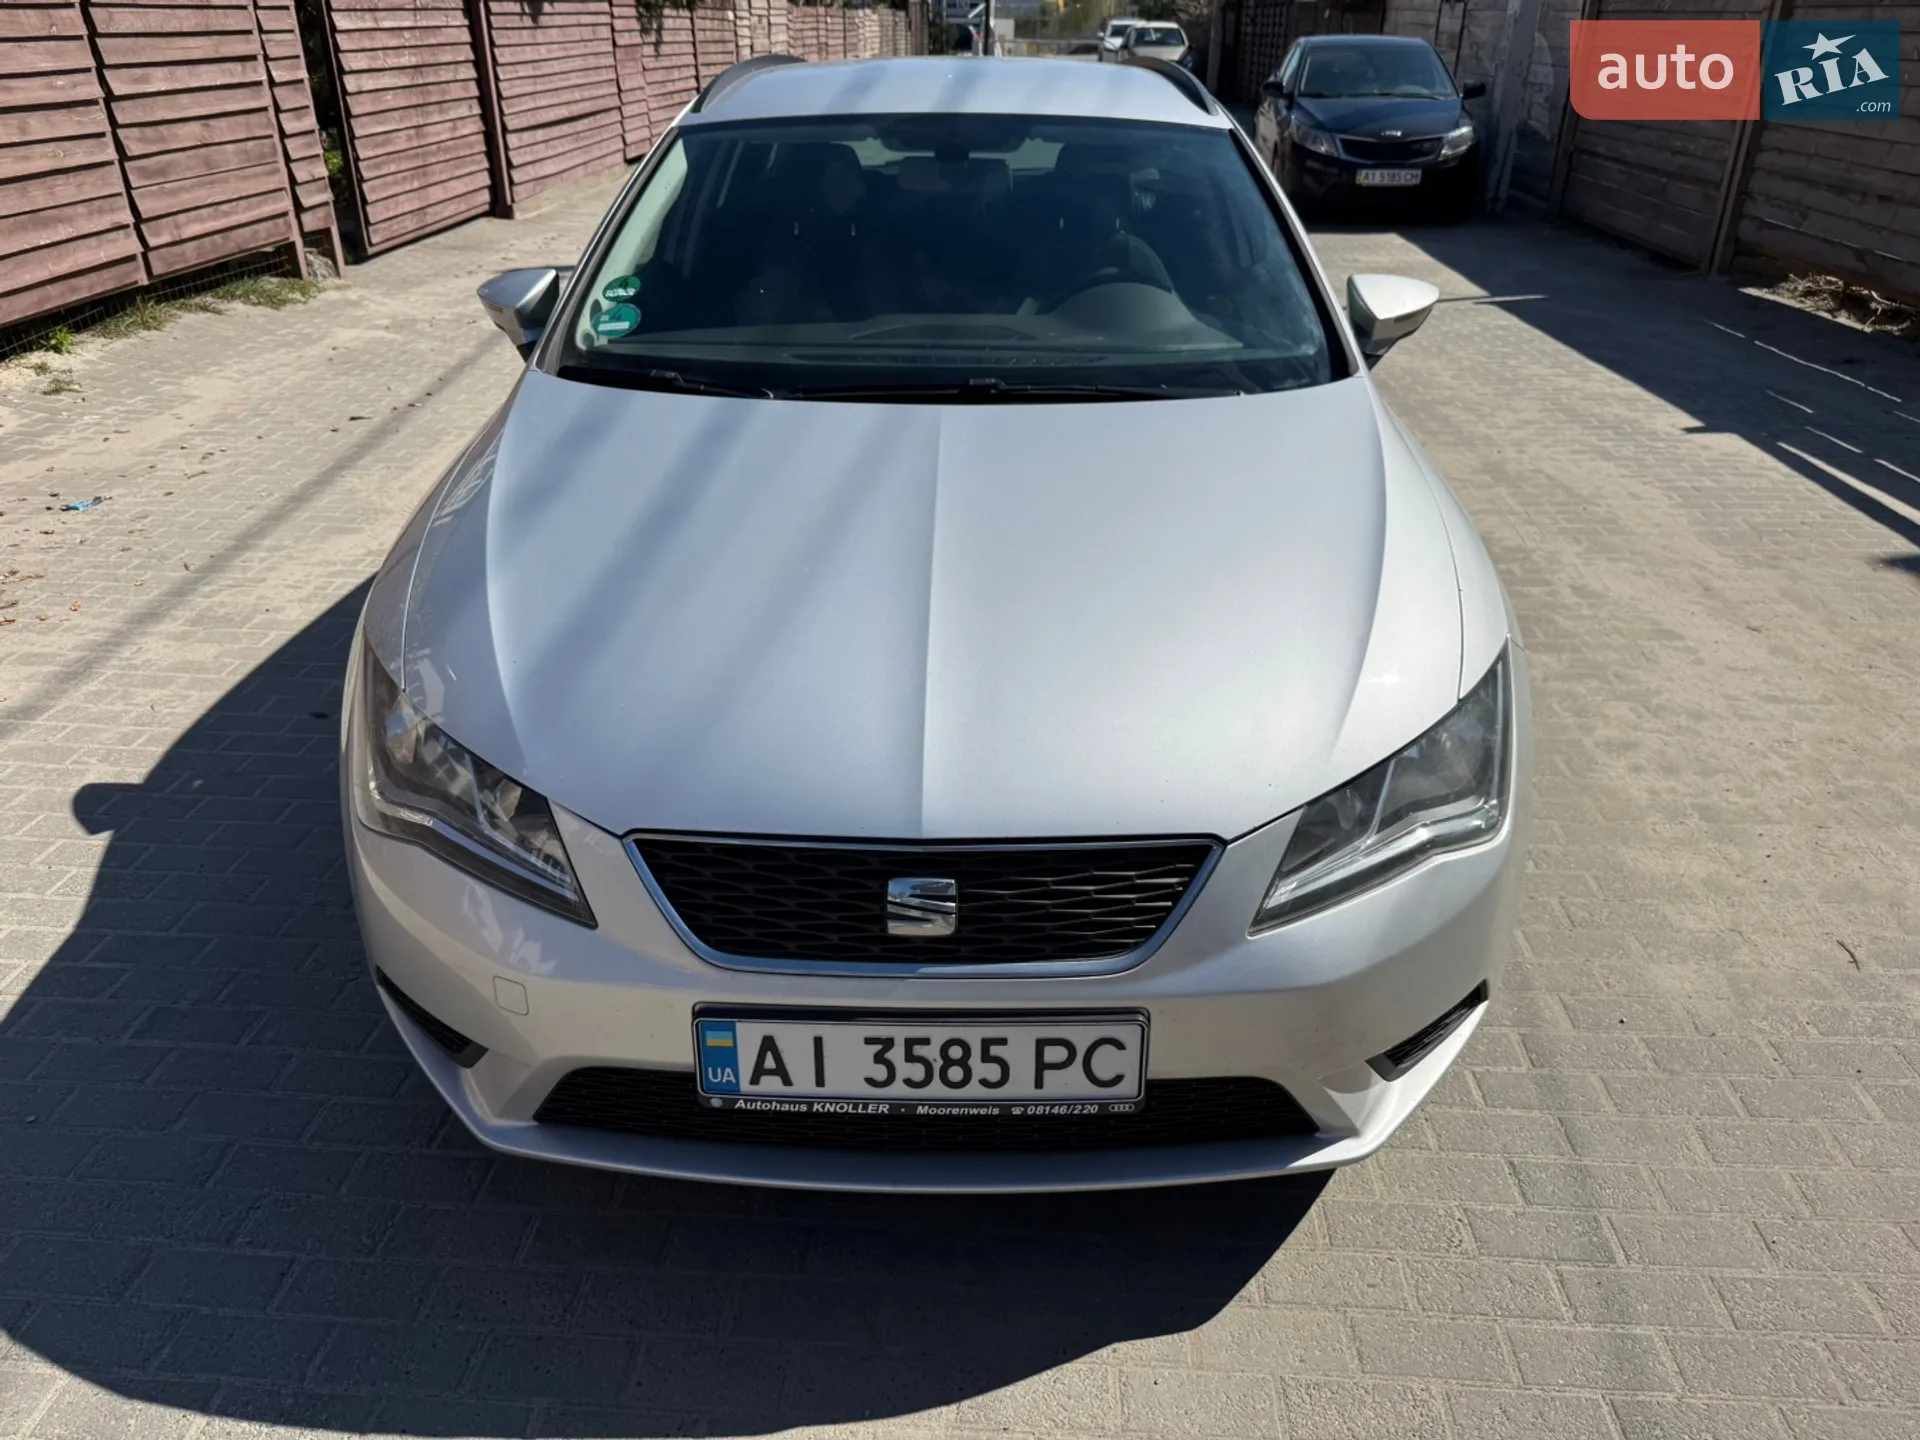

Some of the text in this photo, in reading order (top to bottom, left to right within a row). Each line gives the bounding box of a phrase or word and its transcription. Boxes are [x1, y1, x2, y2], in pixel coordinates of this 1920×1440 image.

[749, 1034, 1127, 1090] AI 3585 PC
[707, 1067, 736, 1083] UA
[735, 1099, 1098, 1115] Autohaus KNOLLER Moorenweis 08146/220
